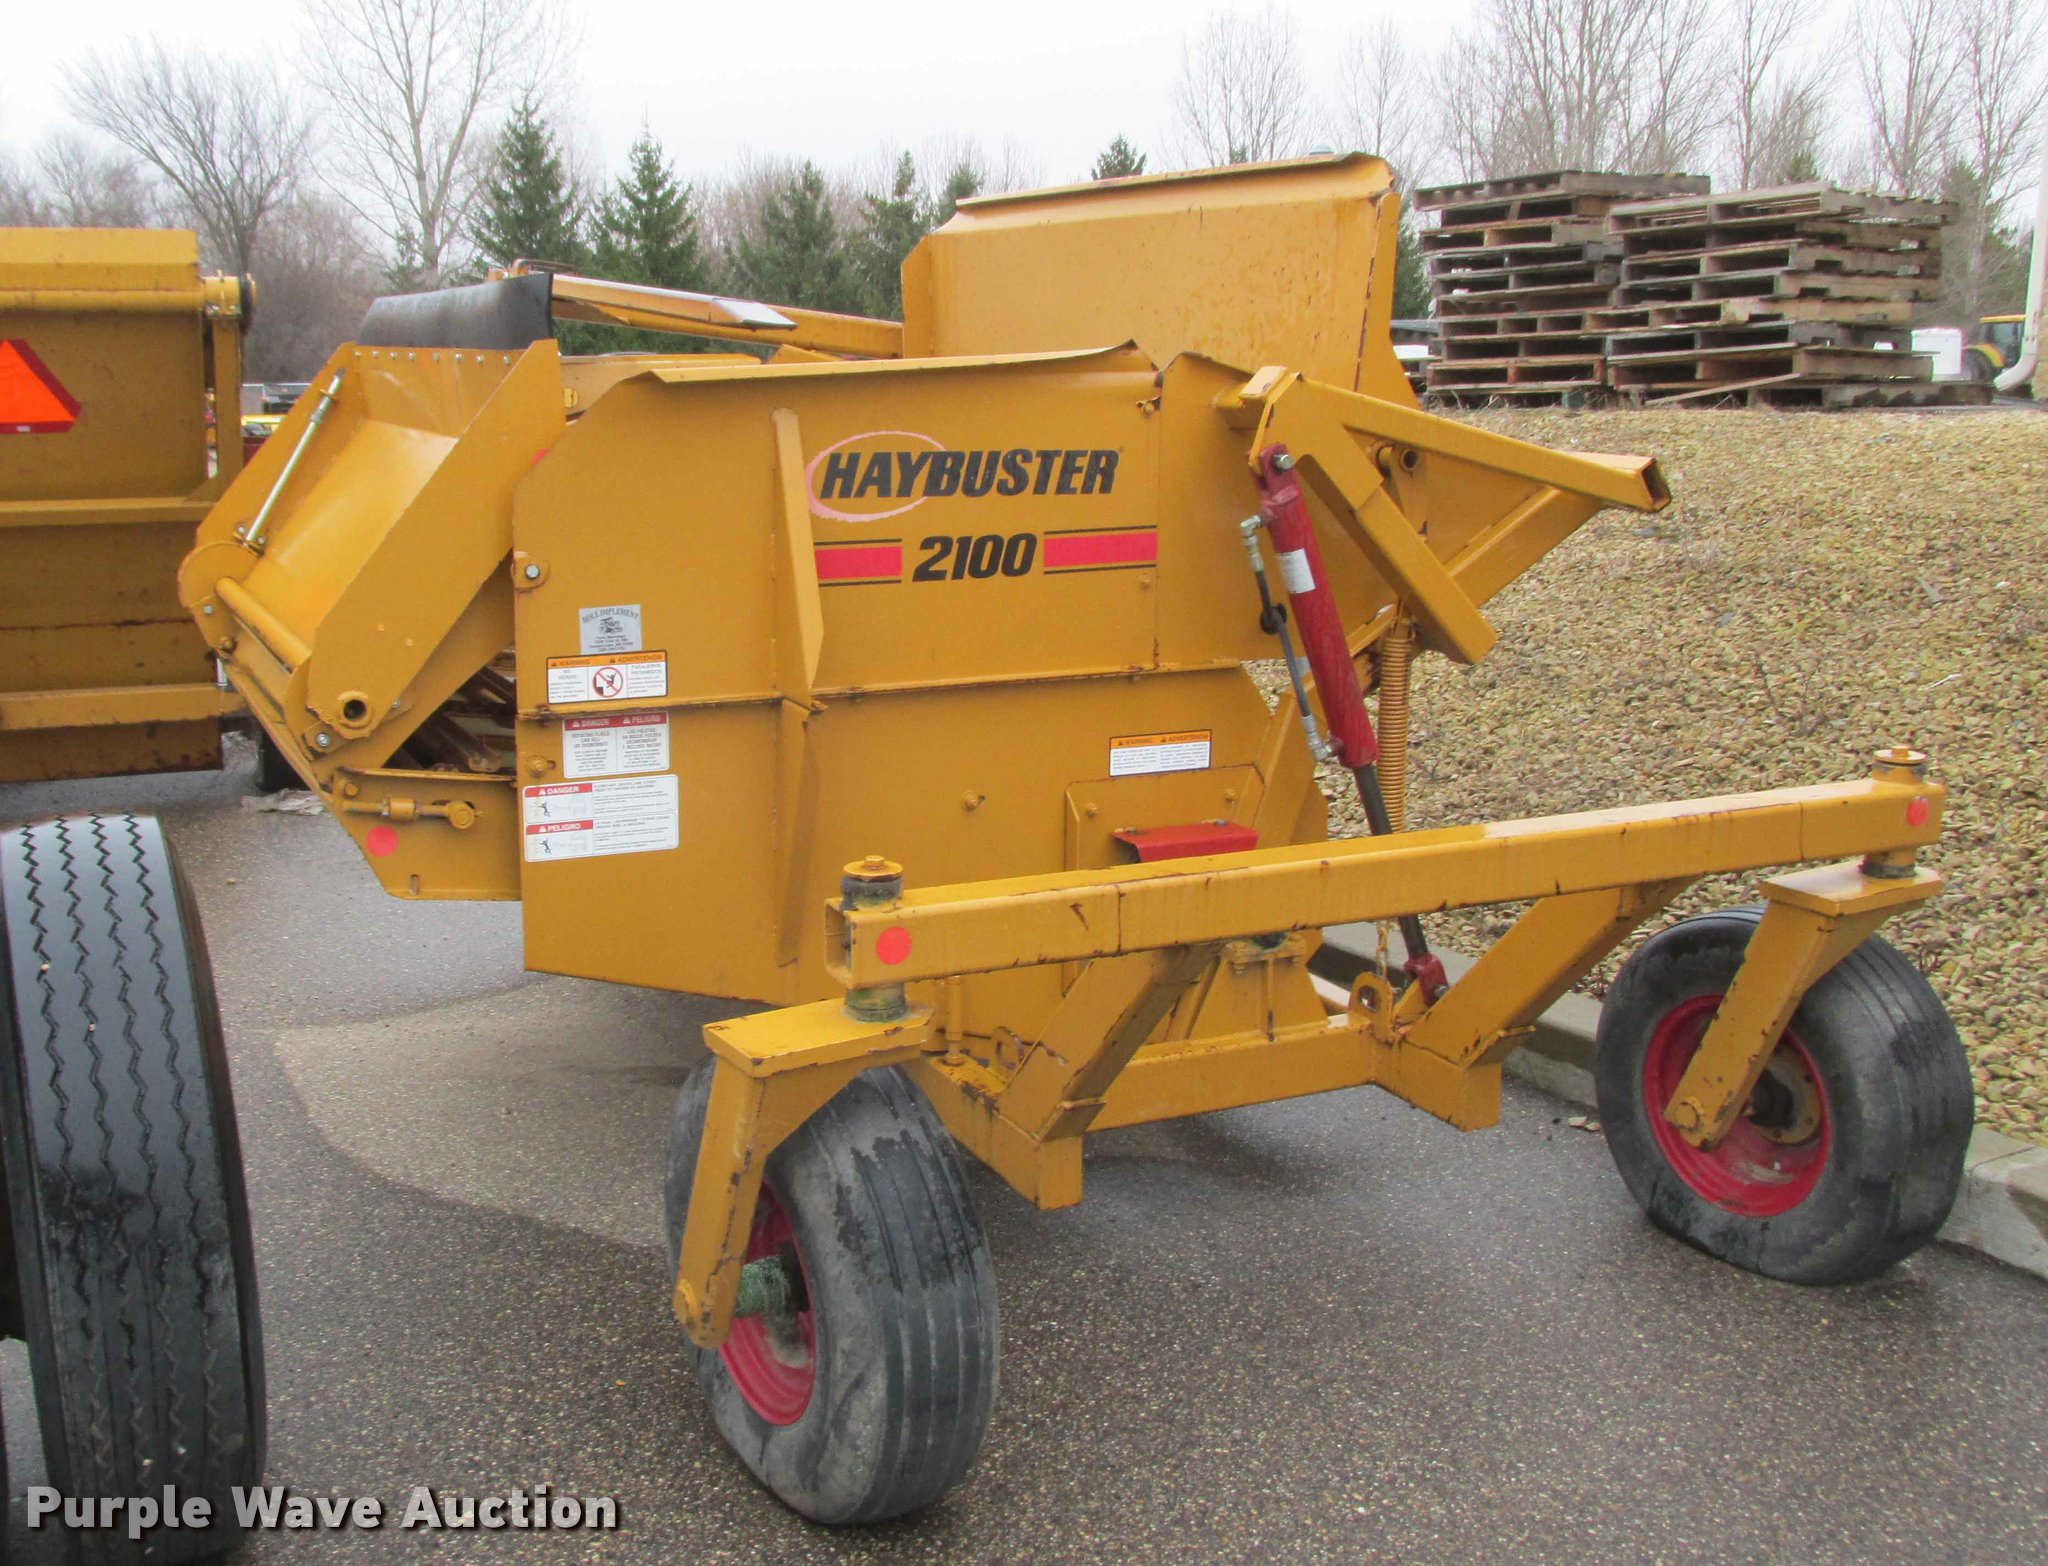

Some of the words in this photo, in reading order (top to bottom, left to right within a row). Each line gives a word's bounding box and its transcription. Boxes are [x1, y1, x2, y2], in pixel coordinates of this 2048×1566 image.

[820, 448, 1120, 499] HAYBUSTER
[912, 532, 1038, 582] 2100
[581, 718, 610, 727] DANGER
[631, 715, 661, 724] PELIGRO
[547, 786, 579, 796] DANGER
[547, 823, 581, 833] PELIGRO
